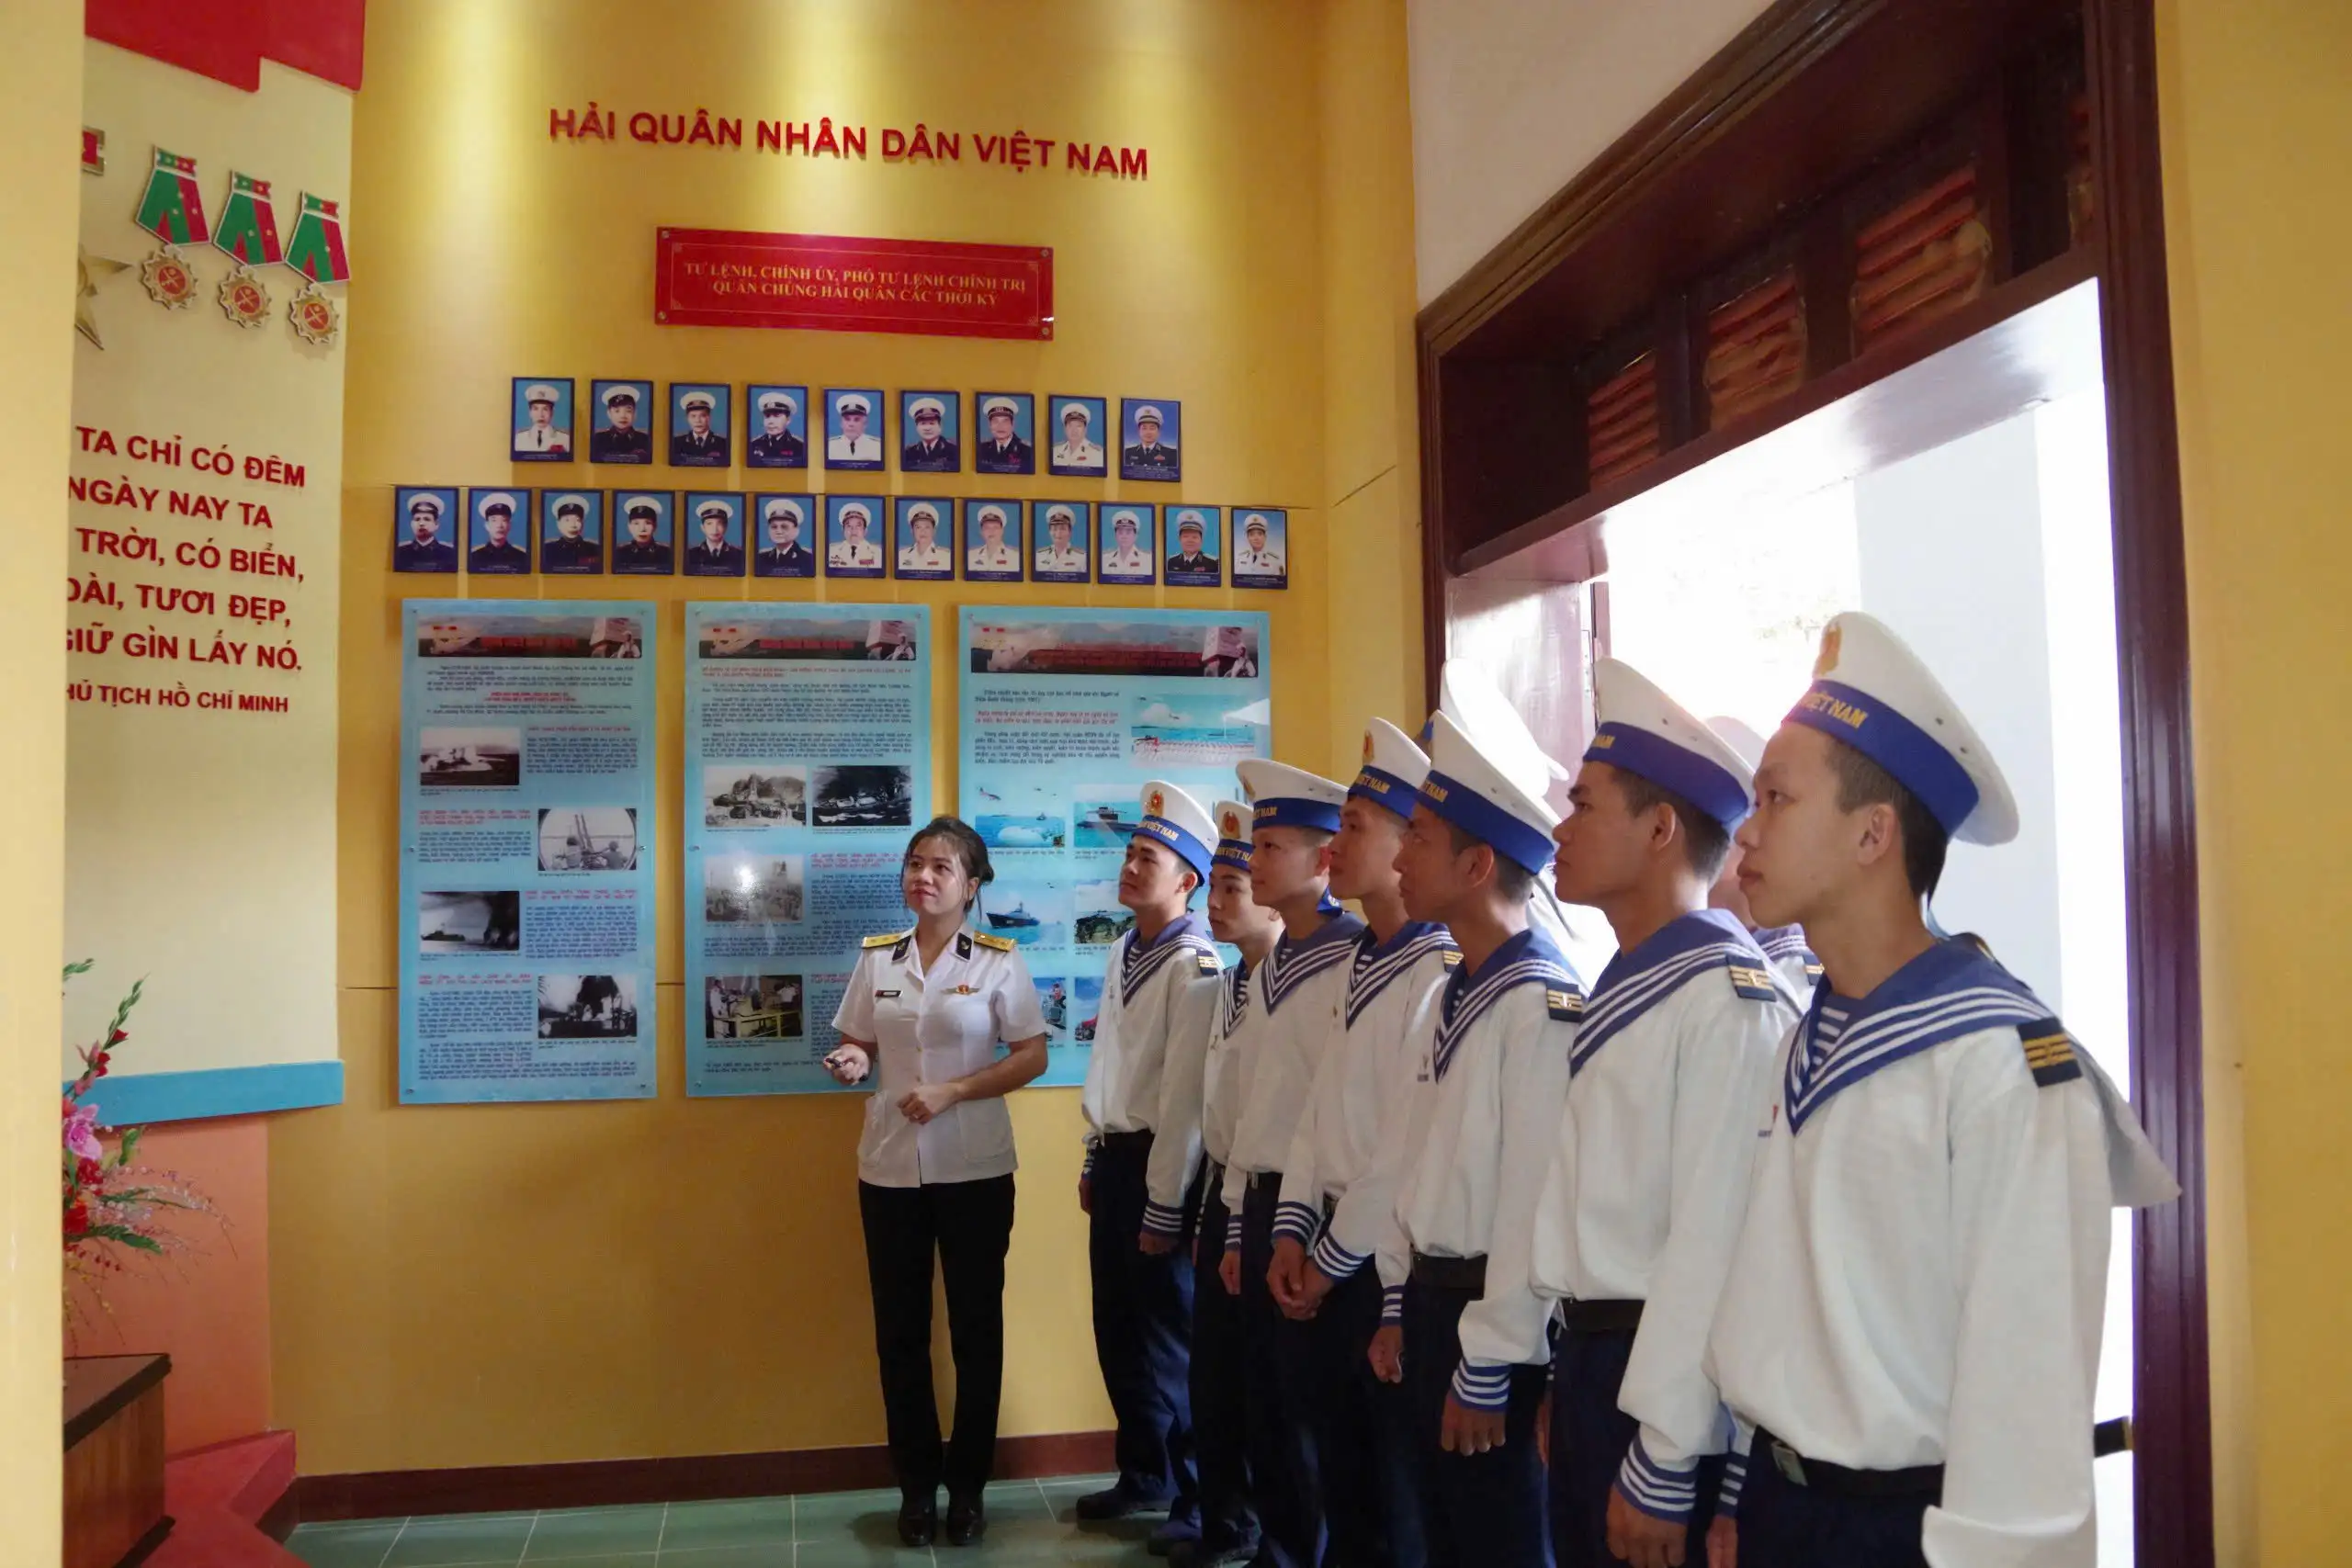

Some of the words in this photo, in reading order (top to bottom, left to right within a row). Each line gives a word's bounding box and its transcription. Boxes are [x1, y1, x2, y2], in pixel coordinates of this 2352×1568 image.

[549, 101, 616, 140] HẢI
[628, 107, 742, 147] QUÂN
[756, 117, 865, 160] NHÂN
[881, 123, 960, 163] DÂN
[972, 130, 1056, 173] VIỆT
[1068, 142, 1148, 179] NAM
[75, 425, 118, 456] TA
[127, 434, 182, 467] CHỈ
[191, 444, 234, 476] CÓ
[243, 455, 305, 488] ĐÊM
[69, 475, 160, 512] NGÀY
[169, 490, 231, 522] NAY
[237, 502, 273, 528] TA
[75, 526, 165, 567] TRỜI,
[175, 537, 220, 569] CÓ
[230, 542, 304, 583] BIỂN,
[135, 583, 214, 615] TƯƠI
[229, 594, 291, 628] ĐẸP,
[67, 622, 114, 654] IỮ
[122, 625, 178, 660] GÌN
[189, 629, 248, 665] LẤY
[256, 639, 302, 671] NÓ.
[97, 684, 152, 707] TỊCH
[158, 681, 190, 707] HỒ
[198, 690, 233, 710] CHÍ
[238, 694, 288, 713] MINH
[1827, 698, 1869, 729] NAM
